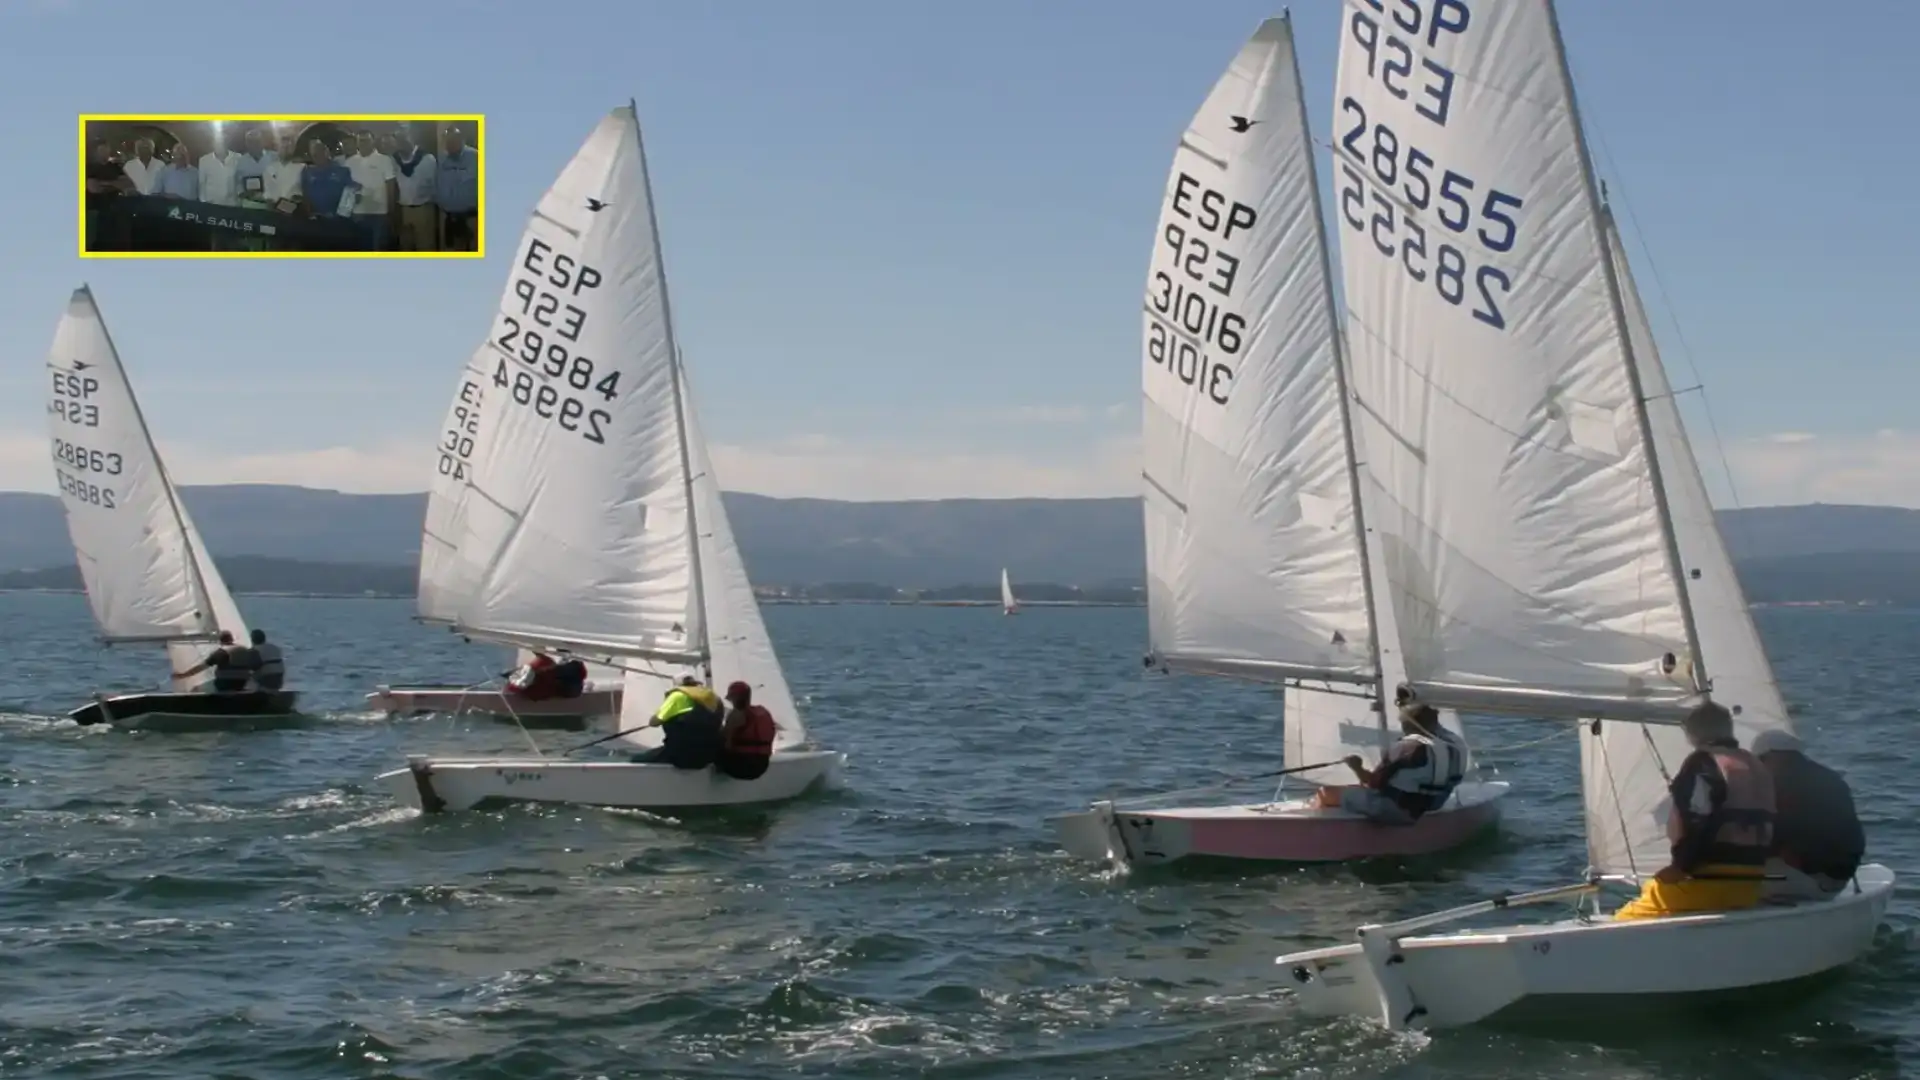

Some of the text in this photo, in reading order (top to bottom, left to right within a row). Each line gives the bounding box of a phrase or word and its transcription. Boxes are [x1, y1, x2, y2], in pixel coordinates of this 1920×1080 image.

[1364, 0, 1470, 48] SP
[1343, 96, 1522, 252] 28555
[185, 212, 203, 223] PL
[207, 216, 253, 232] SAILS
[1172, 172, 1257, 240] ESP
[524, 238, 601, 296] ESP
[1153, 271, 1246, 354] 31016
[53, 372, 99, 399] ESP
[498, 317, 621, 401] 29984
[55, 438, 122, 475] 28863
